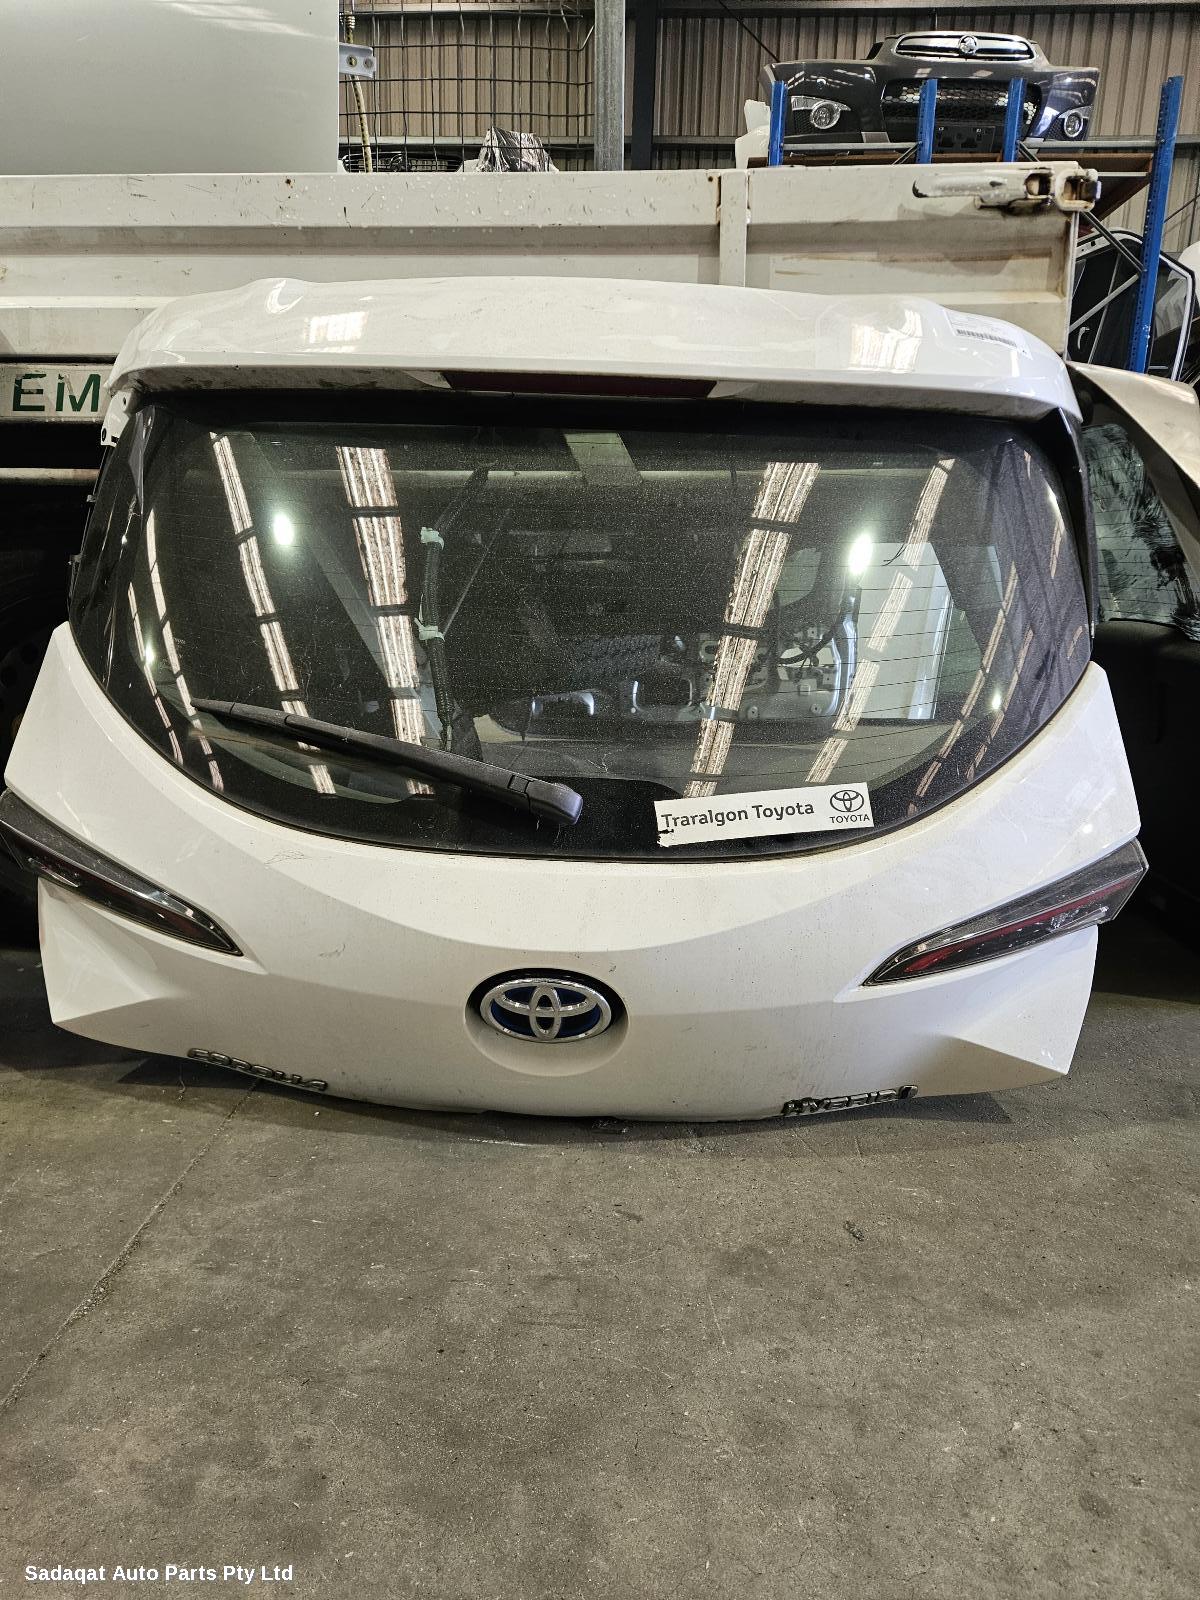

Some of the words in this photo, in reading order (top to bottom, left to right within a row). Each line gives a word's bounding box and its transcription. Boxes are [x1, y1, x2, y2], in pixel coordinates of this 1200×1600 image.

[661, 809, 749, 828] Traralgon
[752, 801, 815, 821] Toyota
[830, 814, 870, 824] TOYOTA
